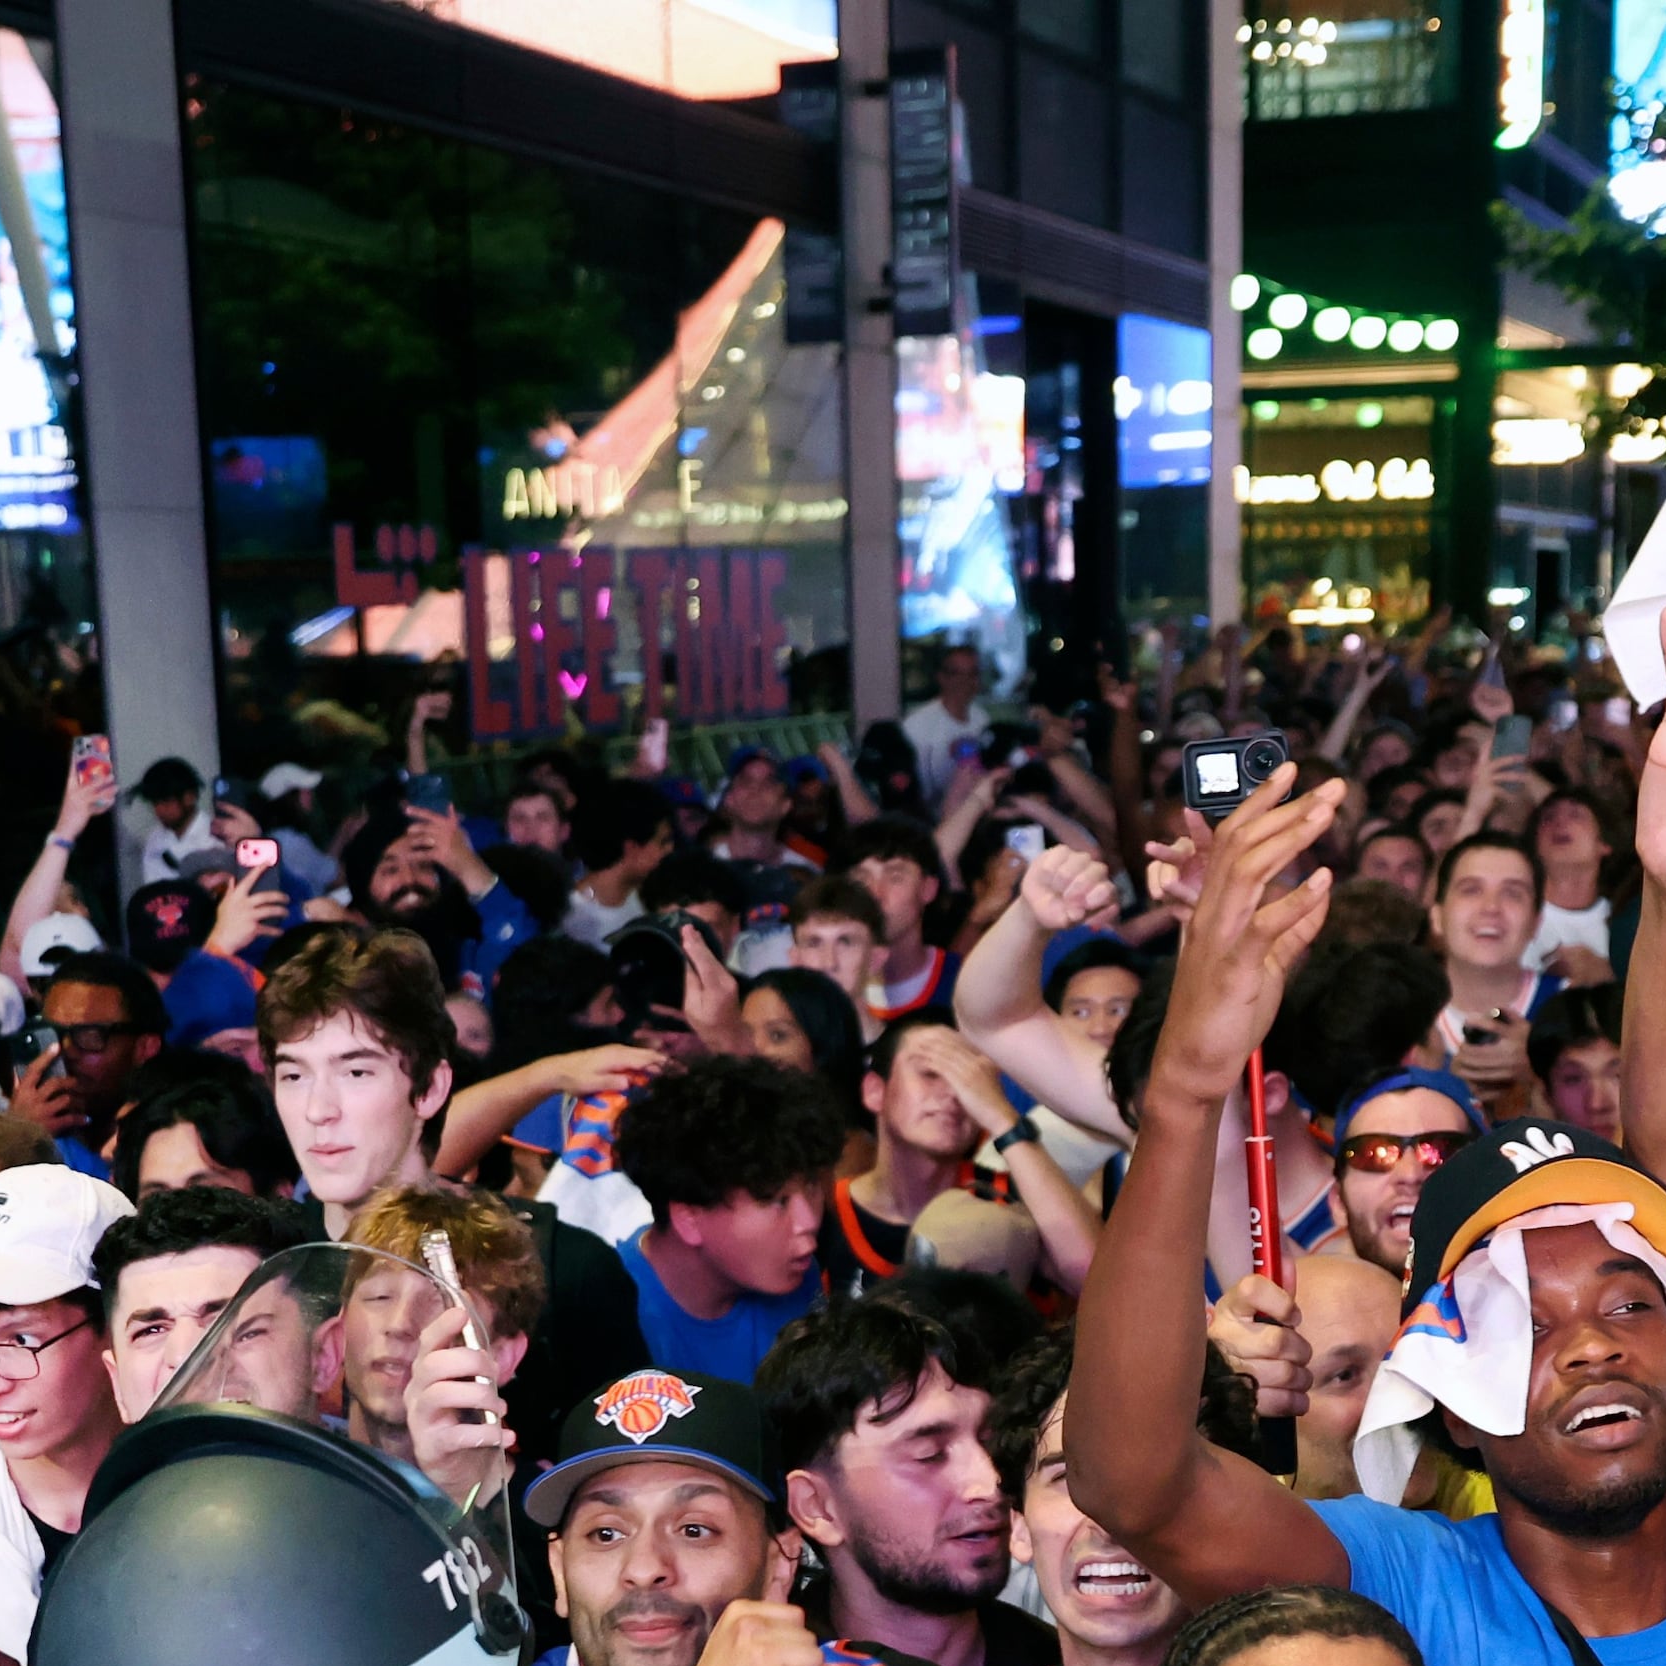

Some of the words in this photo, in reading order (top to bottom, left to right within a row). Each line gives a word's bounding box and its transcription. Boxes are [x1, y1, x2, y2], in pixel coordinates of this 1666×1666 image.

[463, 544, 621, 742] LIFE
[626, 546, 790, 722] TIME
[595, 1374, 692, 1417] KNICKS
